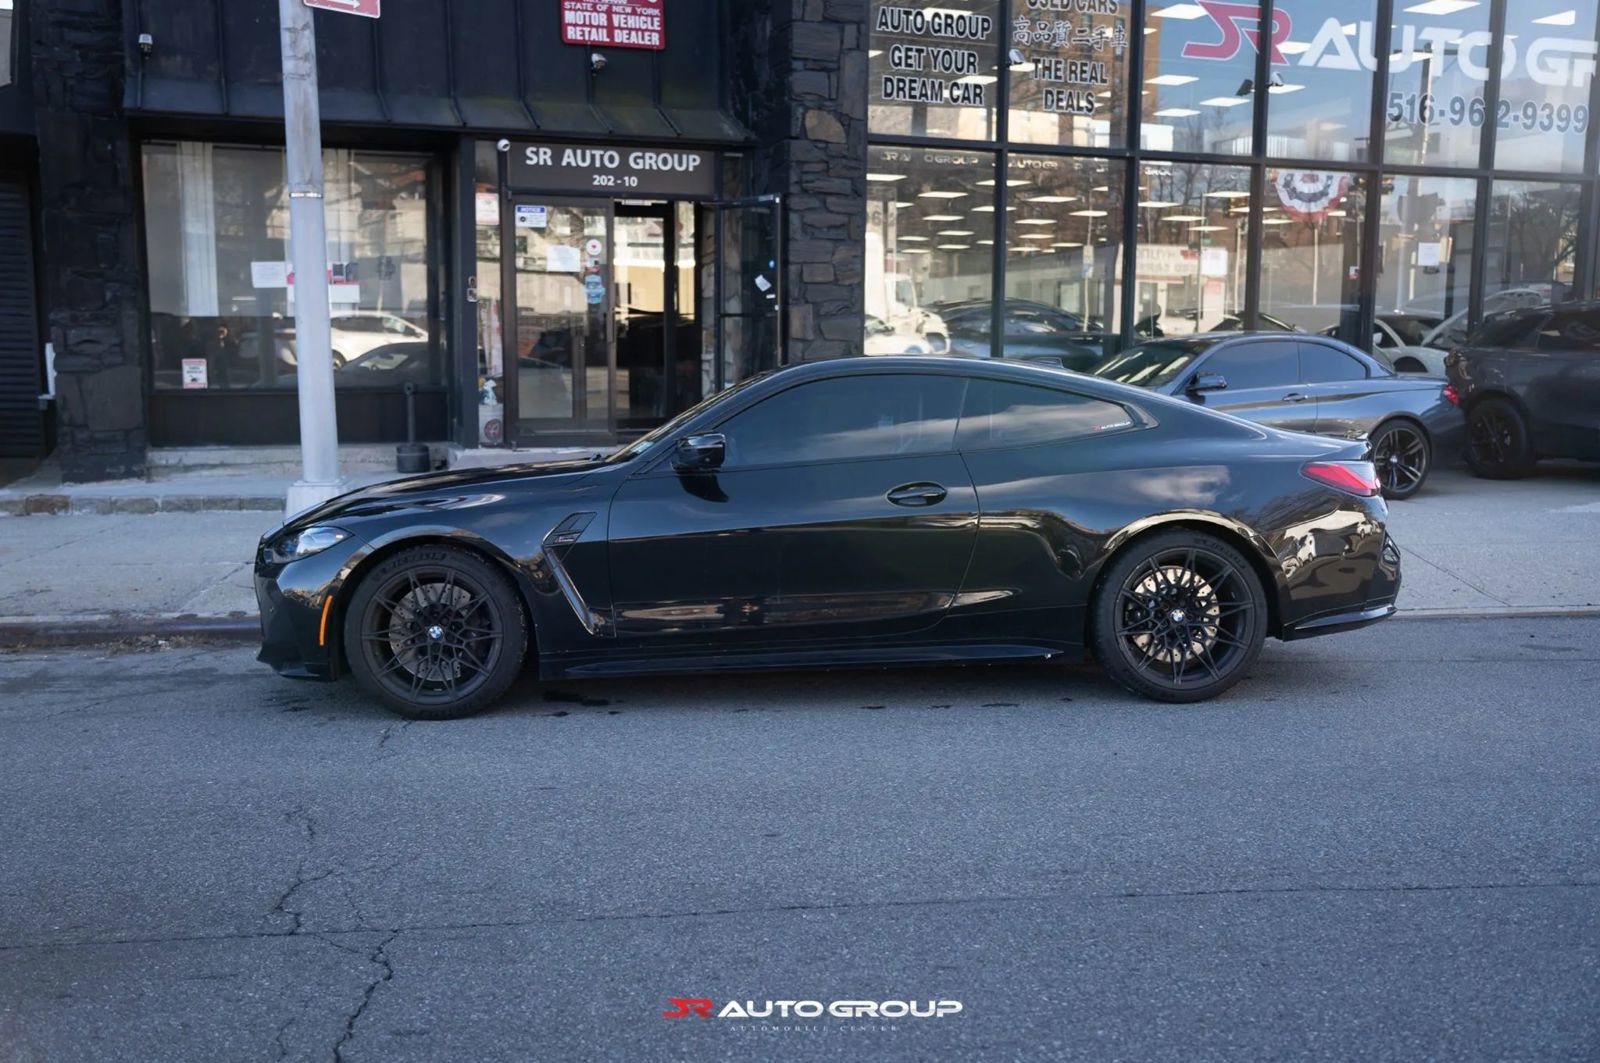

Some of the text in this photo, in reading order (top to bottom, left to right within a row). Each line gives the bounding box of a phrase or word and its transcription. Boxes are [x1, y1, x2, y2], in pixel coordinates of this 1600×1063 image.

[564, 1, 593, 11] STATE
[596, 4, 609, 12] OF
[612, 5, 633, 14] NEW
[635, 7, 661, 16] YORK
[564, 10, 661, 31] MOTOR VEHICLE
[876, 6, 993, 40] AUTO GROUP
[567, 26, 660, 46] RETAIL DEALER
[1012, 15, 1128, 52] 高品質二手車
[889, 43, 979, 75] GET YOUR
[1297, 17, 1518, 81] AUTO
[1031, 56, 1109, 85] THE REAL
[882, 74, 985, 107] DREAM CAR
[1043, 87, 1095, 114] DEALS
[525, 146, 701, 172] SR AUTO GROUP
